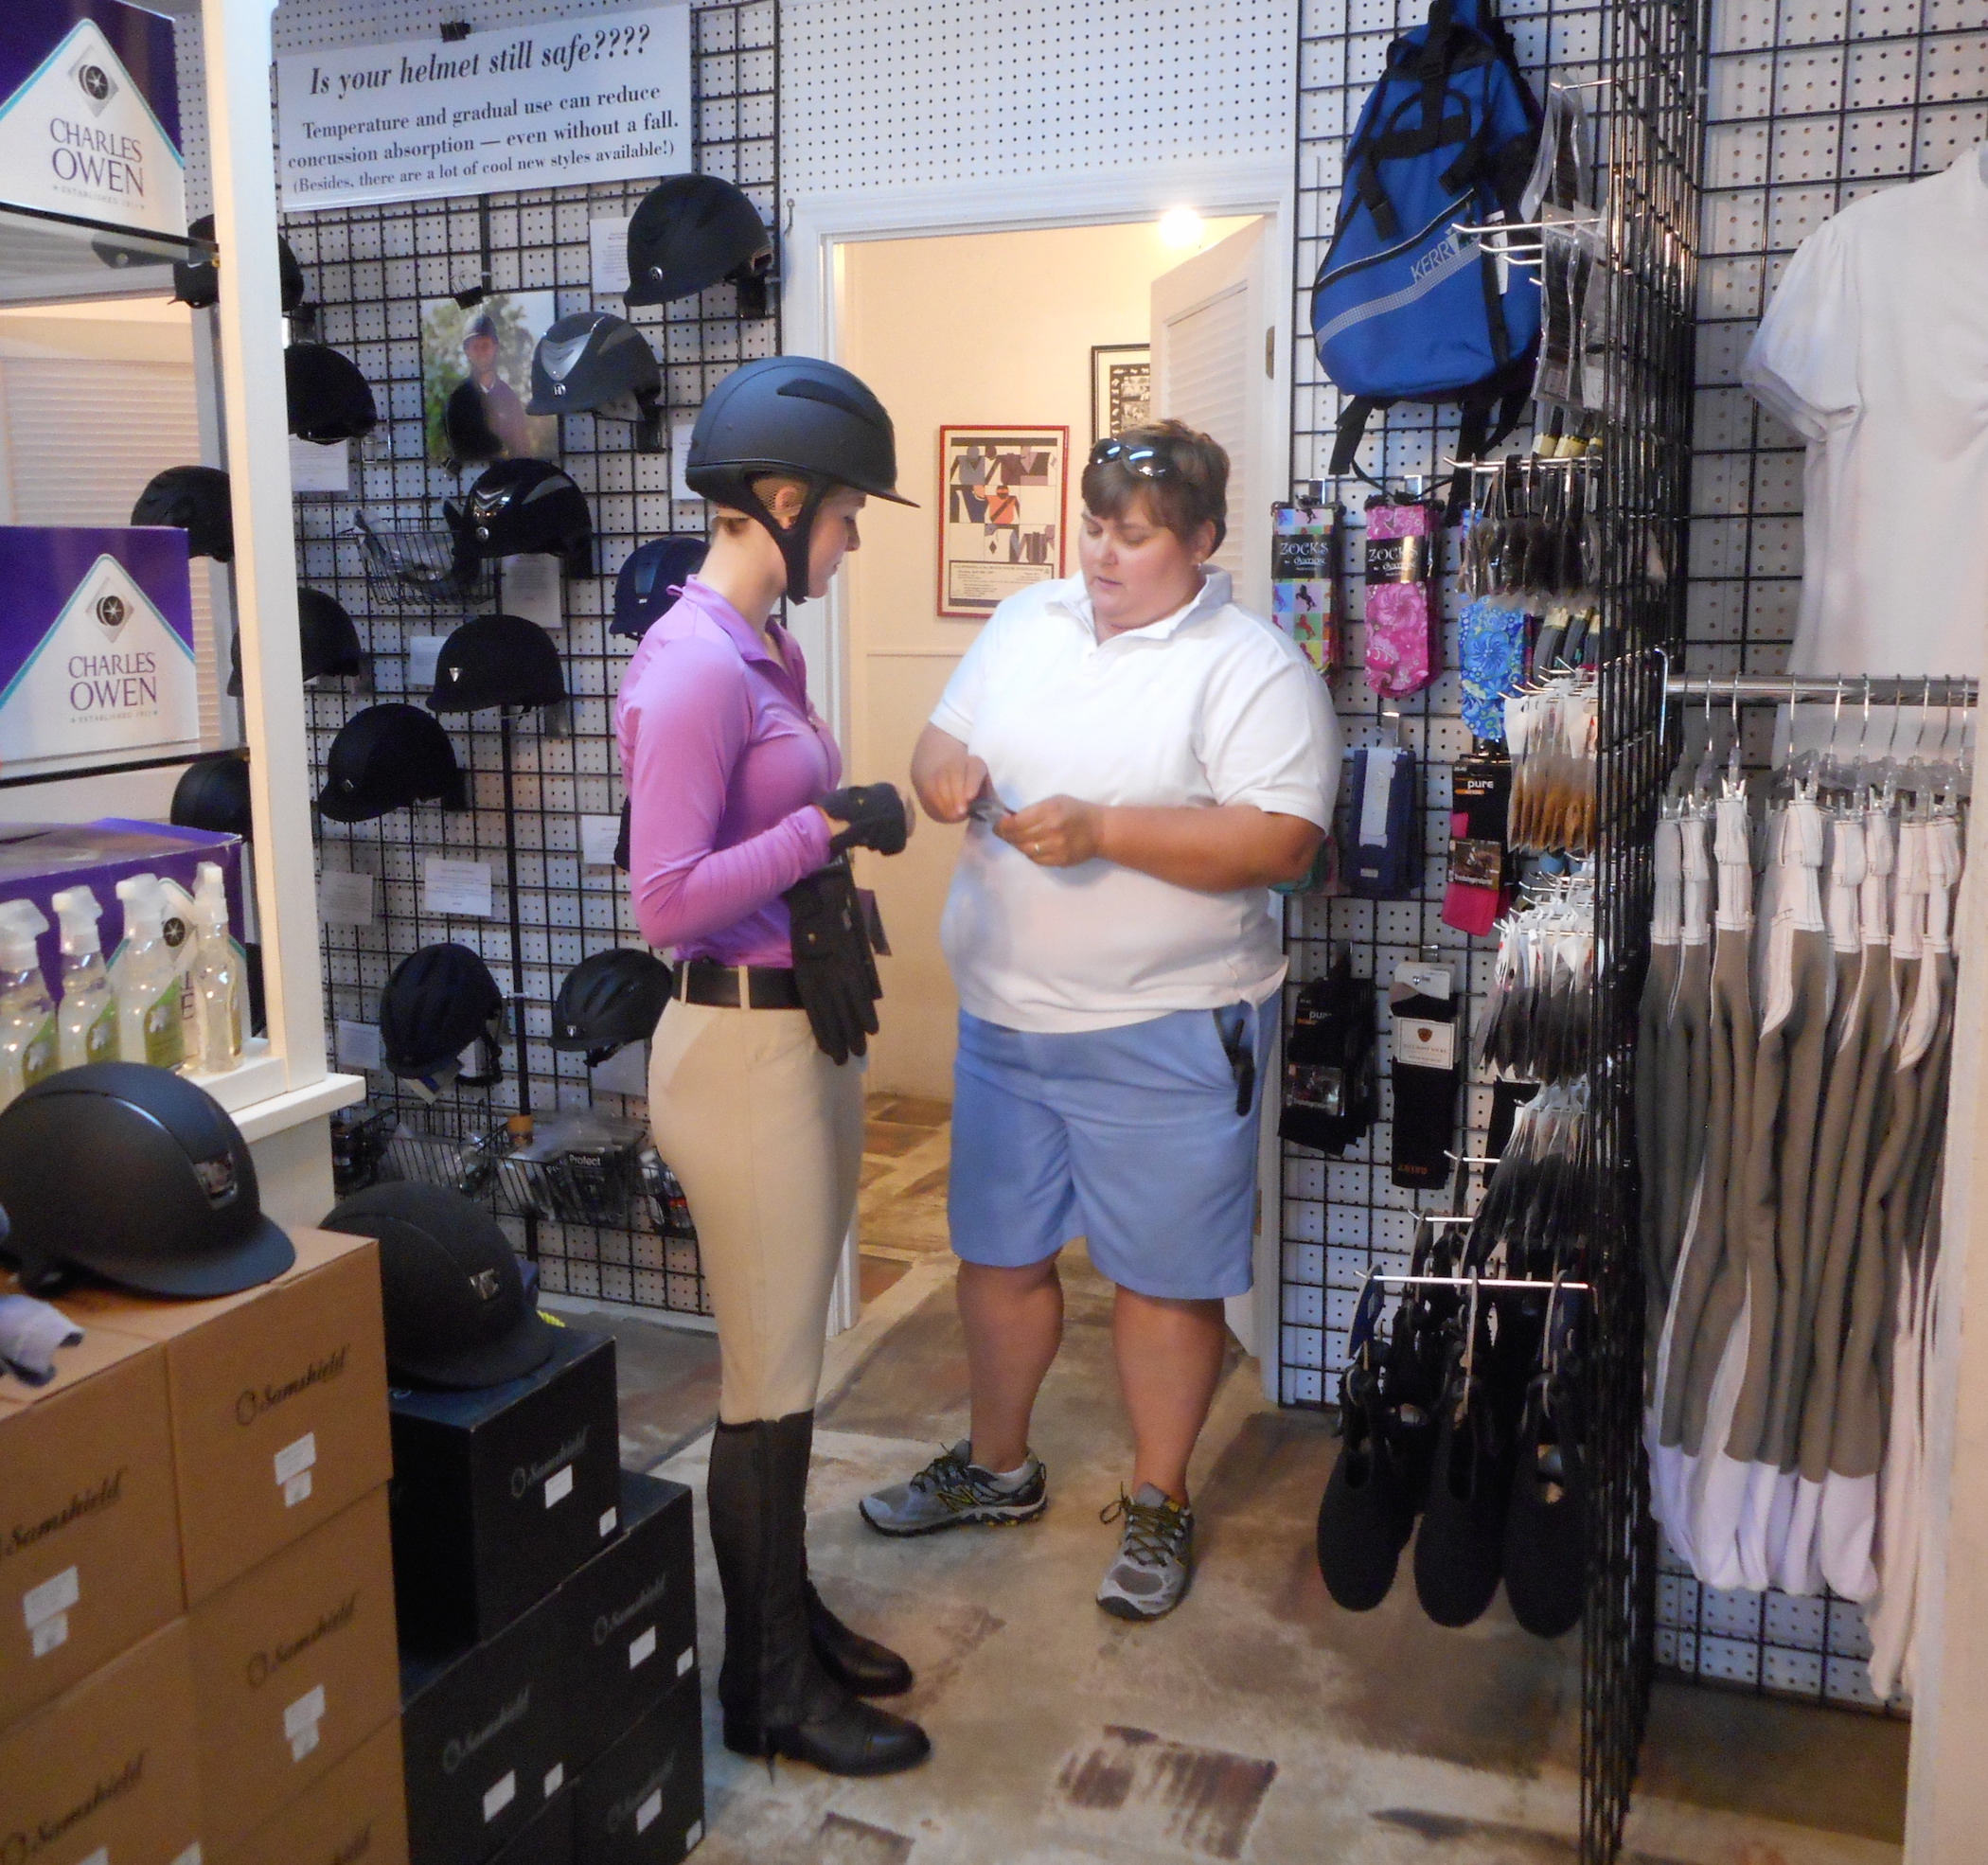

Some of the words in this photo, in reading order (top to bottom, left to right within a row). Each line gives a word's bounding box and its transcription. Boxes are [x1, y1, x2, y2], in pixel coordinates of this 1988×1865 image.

[310, 67, 330, 95] Is
[338, 68, 392, 99] your
[399, 53, 479, 84] helmet
[489, 41, 533, 73] still
[541, 24, 650, 72] safe????
[303, 116, 410, 141] Temperature
[416, 107, 447, 127] and
[453, 98, 517, 128] gradual
[524, 99, 552, 115] use
[559, 95, 590, 111] can
[597, 84, 661, 106] reduce
[50, 117, 142, 163] CHARLES
[288, 147, 378, 169] concussion
[383, 136, 474, 160] absorption
[506, 131, 547, 147] even
[554, 119, 619, 140] without
[627, 120, 637, 133] a
[644, 110, 679, 131] fall.
[52, 148, 144, 198] OWEN
[359, 171, 395, 186] there
[399, 169, 422, 183] are
[427, 169, 435, 180] a
[439, 164, 458, 179] lot
[463, 161, 479, 177] of
[482, 157, 512, 174] cool
[518, 156, 545, 170] new
[551, 150, 590, 169] styles
[595, 140, 674, 162] available!)
[1280, 542, 1328, 556] ZOCKS
[68, 651, 156, 679] CHARLES
[70, 676, 157, 711] OWEN
[569, 1154, 601, 1166] Protect
